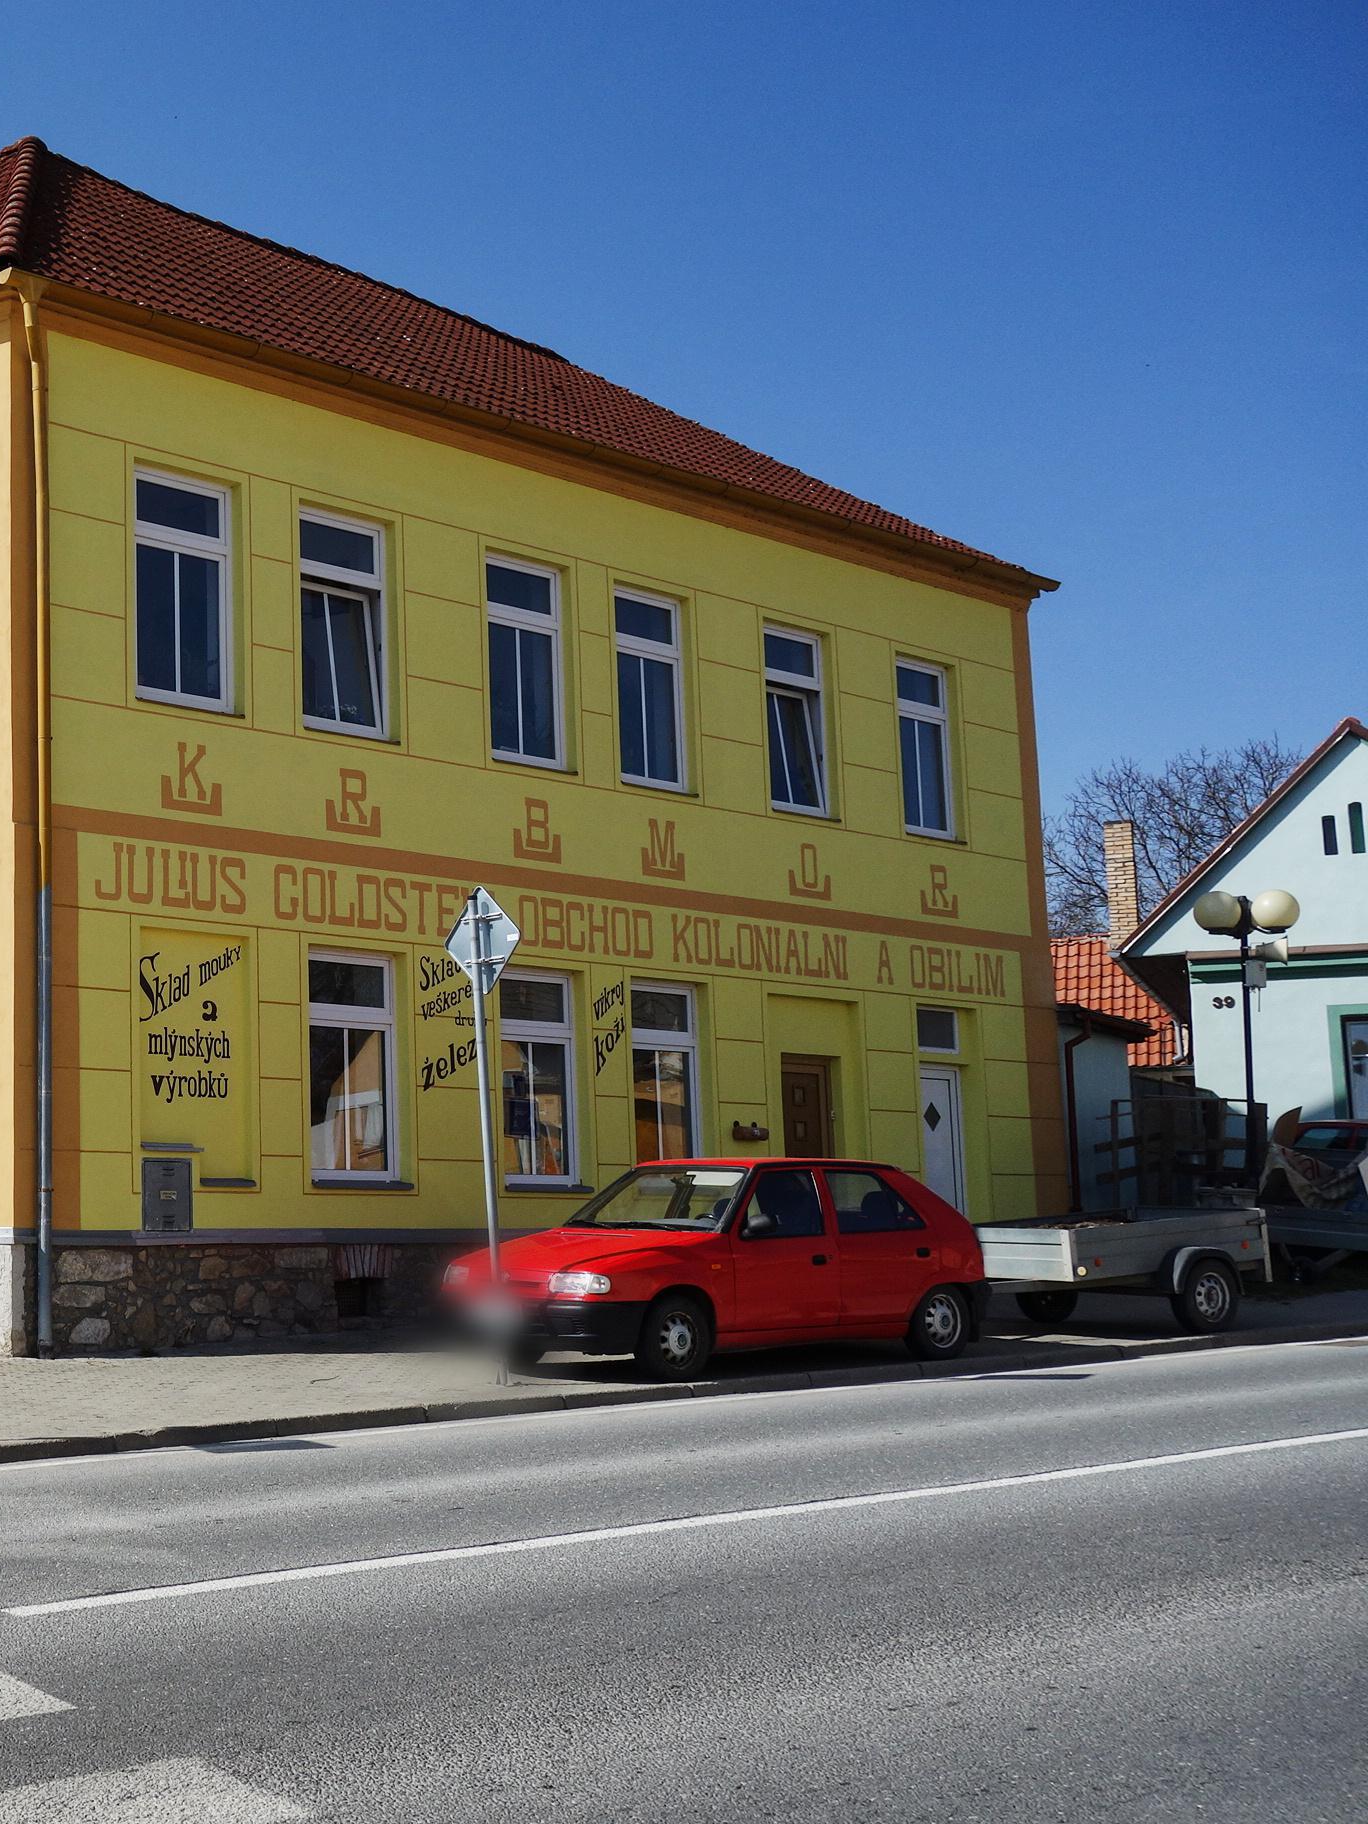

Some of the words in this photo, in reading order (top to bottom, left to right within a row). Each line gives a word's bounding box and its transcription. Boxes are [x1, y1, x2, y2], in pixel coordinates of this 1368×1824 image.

[274, 863, 495, 938] GOLDSTE
[519, 894, 653, 960] OBCHOD
[672, 912, 849, 981] KOLONIALNI
[877, 940, 894, 985] A
[909, 944, 1006, 998] OBILIM
[139, 951, 190, 1022] Sklad
[1212, 995, 1236, 1010] 39
[202, 1000, 218, 1021] a
[454, 1010, 487, 1027] dru
[148, 1027, 231, 1064] mlýnských
[151, 1069, 229, 1104] výrobků
